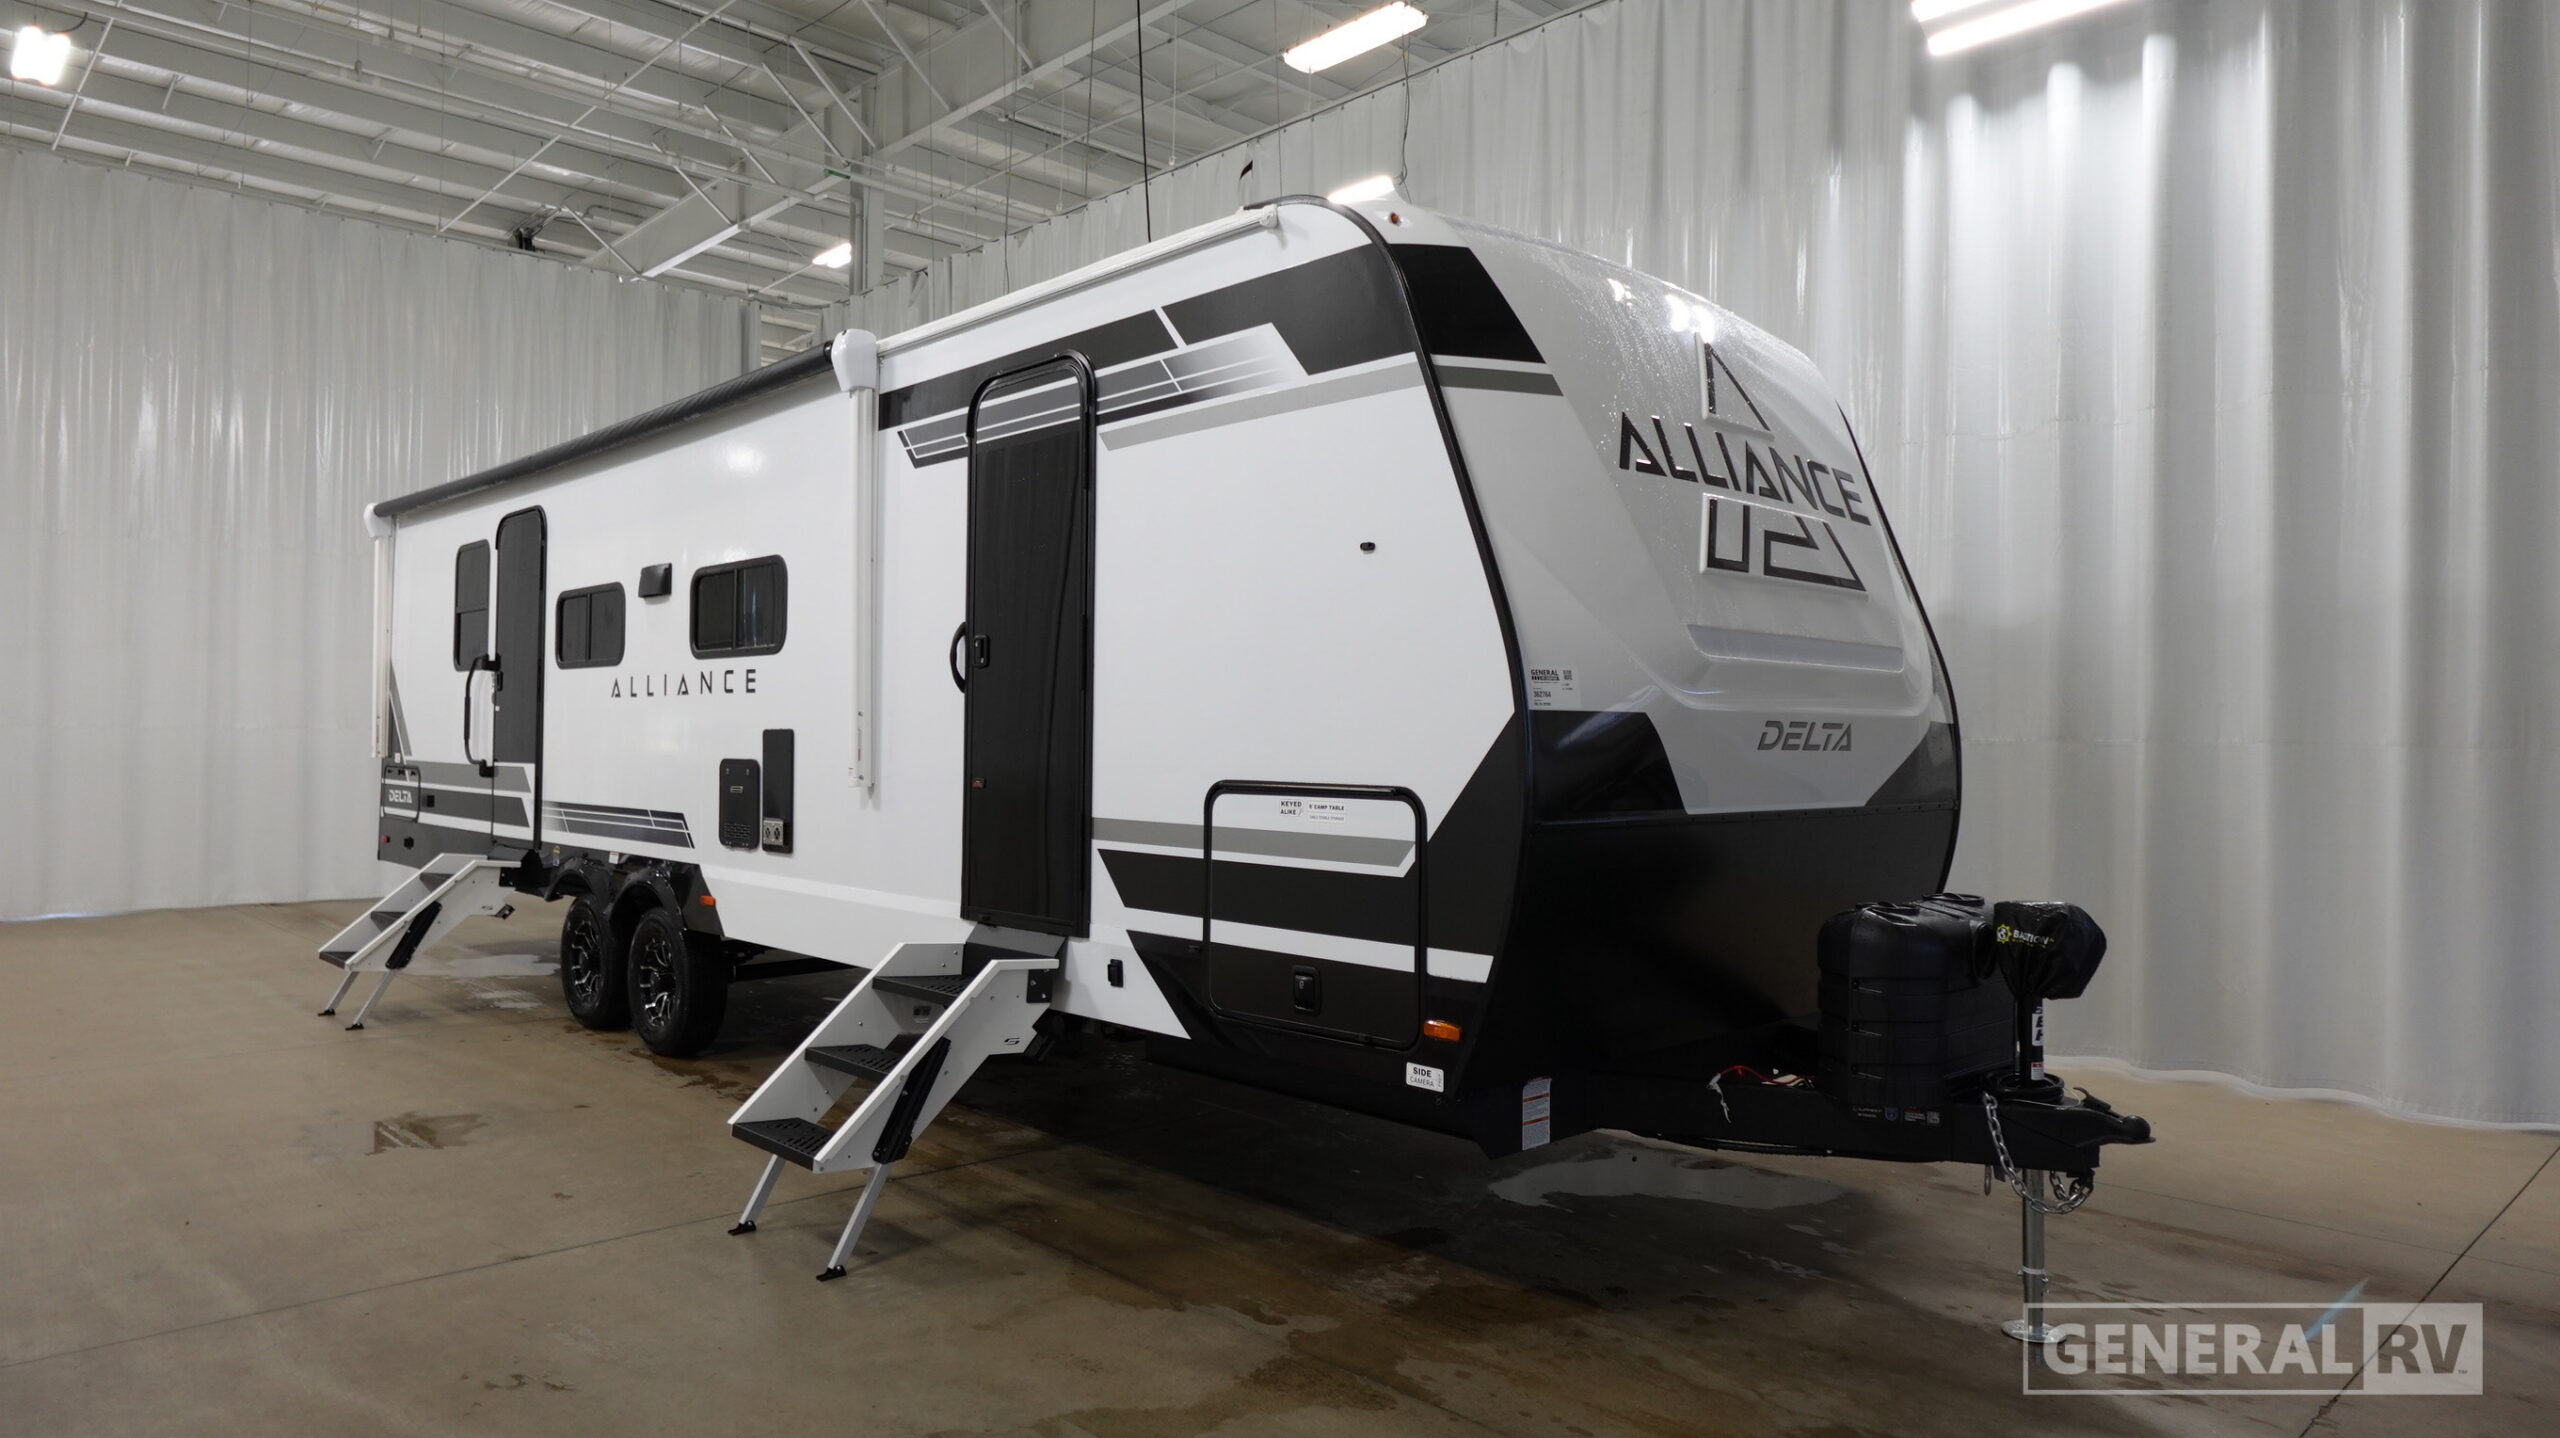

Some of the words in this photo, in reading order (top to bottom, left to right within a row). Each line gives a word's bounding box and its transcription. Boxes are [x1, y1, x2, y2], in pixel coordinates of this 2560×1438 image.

[1619, 411, 1872, 526] ALLIANCE
[611, 669, 756, 698] ALLIANCE
[1757, 720, 1852, 752] DELTA
[388, 789, 413, 803] DELTA
[1410, 1076, 1435, 1087] CAMERA
[1413, 1066, 1432, 1078] SIDE
